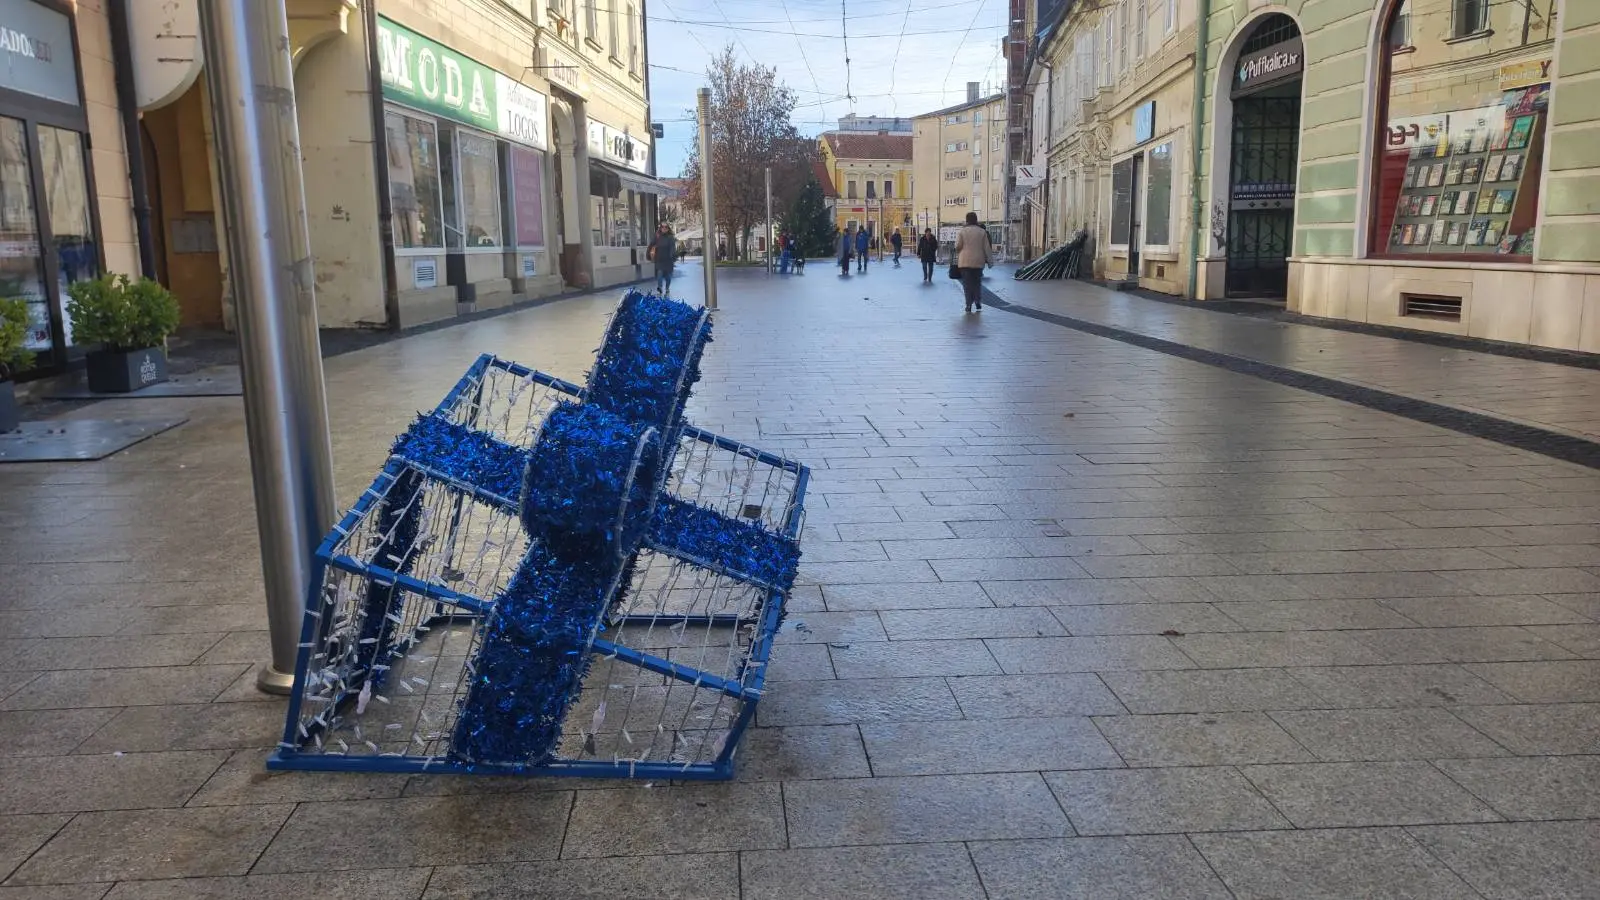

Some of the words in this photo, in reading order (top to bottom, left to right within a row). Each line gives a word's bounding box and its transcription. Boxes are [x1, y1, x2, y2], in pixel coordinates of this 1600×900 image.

[377, 26, 491, 118] MODA
[1248, 51, 1298, 79] Puffkalica.hr
[506, 109, 539, 143] LOGOS
